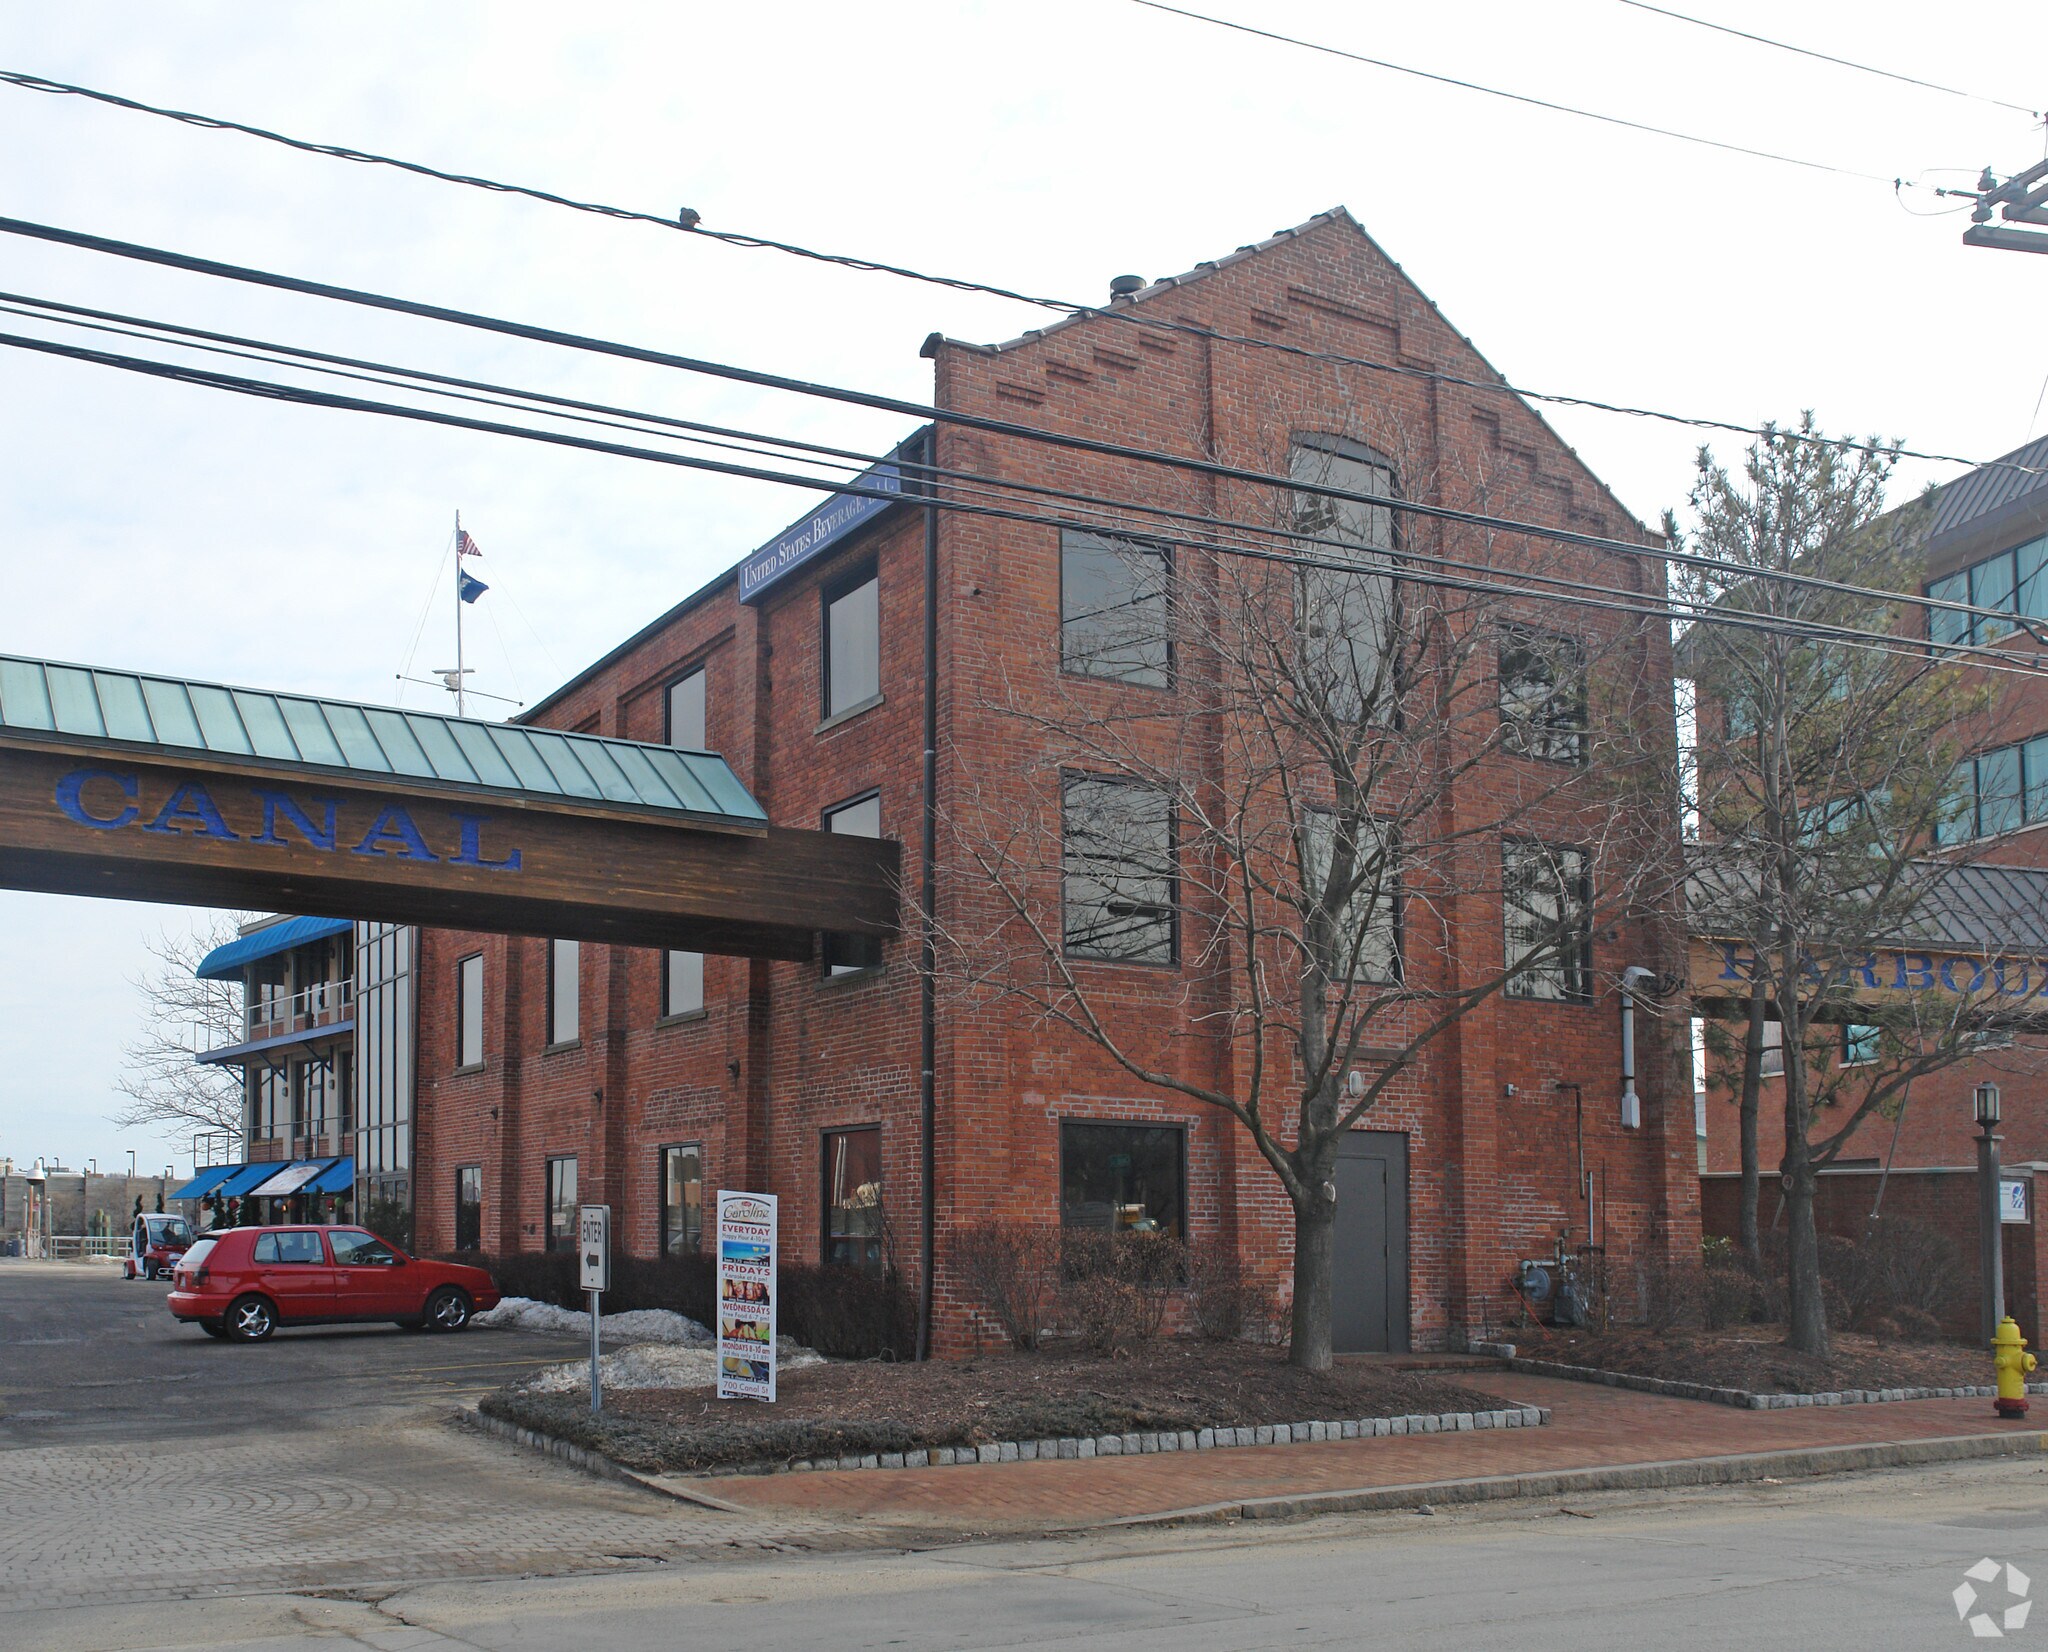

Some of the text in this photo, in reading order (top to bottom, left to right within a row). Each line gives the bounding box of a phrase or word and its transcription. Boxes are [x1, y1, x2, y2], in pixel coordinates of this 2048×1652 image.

[744, 556, 776, 588] UNITED
[779, 532, 810, 567] STATES
[55, 768, 522, 872] CANAL
[723, 1203, 769, 1219] Caroline
[583, 1220, 602, 1243] ENTER
[722, 1224, 770, 1236] EVERYDAY
[722, 1264, 771, 1276] FRIDAYS
[722, 1302, 770, 1315] WEDNESDAYS
[722, 1342, 748, 1352] MONDAYS
[723, 1381, 737, 1389] 700
[739, 1384, 759, 1392] Canal
